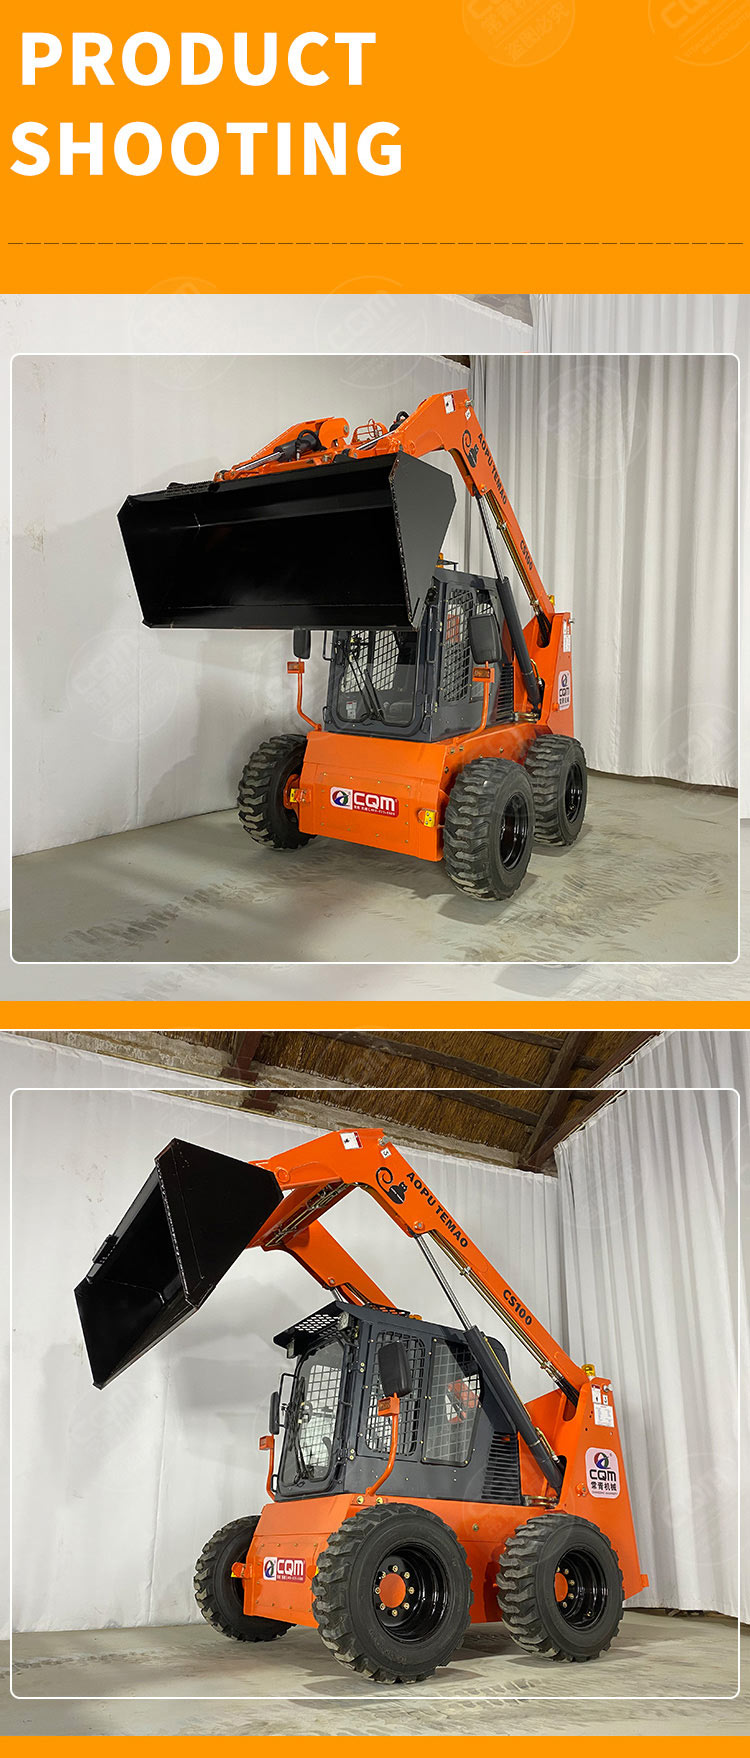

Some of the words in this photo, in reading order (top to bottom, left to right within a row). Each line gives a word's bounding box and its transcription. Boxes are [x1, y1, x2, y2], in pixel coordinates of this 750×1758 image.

[477, 433, 495, 467] AOPU
[491, 466, 508, 506] TEMAO
[519, 539, 533, 572] CS100
[353, 791, 396, 812] CQM
[406, 1172, 437, 1206] AOPU
[435, 1205, 468, 1248] TEMAO
[503, 1289, 533, 1326] CS100
[589, 1469, 617, 1482] CQM
[277, 1559, 304, 1576] CQM
